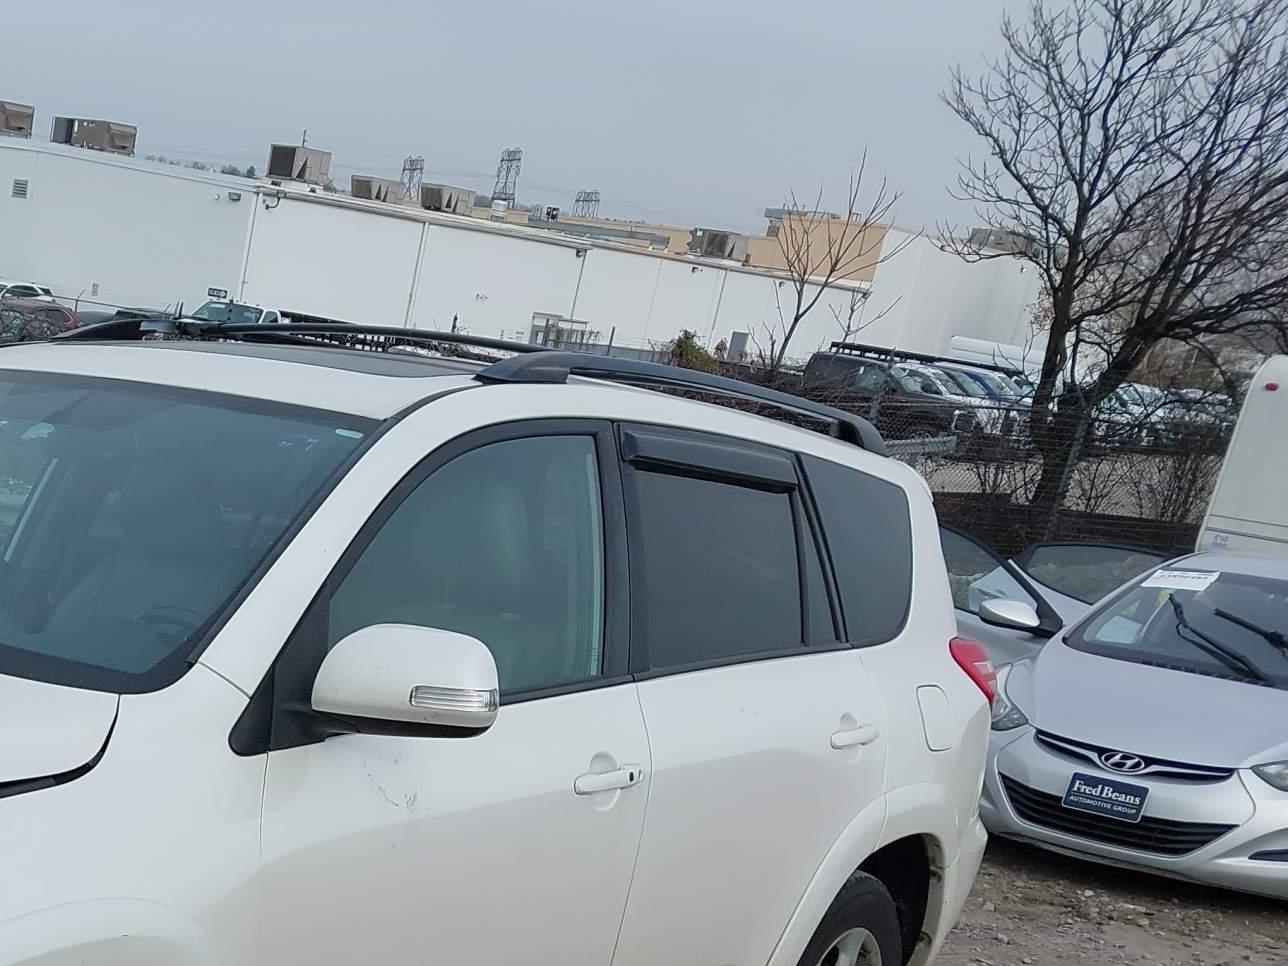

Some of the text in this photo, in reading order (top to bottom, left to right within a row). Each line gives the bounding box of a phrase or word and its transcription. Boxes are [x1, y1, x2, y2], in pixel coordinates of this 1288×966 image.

[1072, 780, 1142, 805] Fred Beans
[1069, 795, 1137, 814] AUTOMOTIVE GROUP
